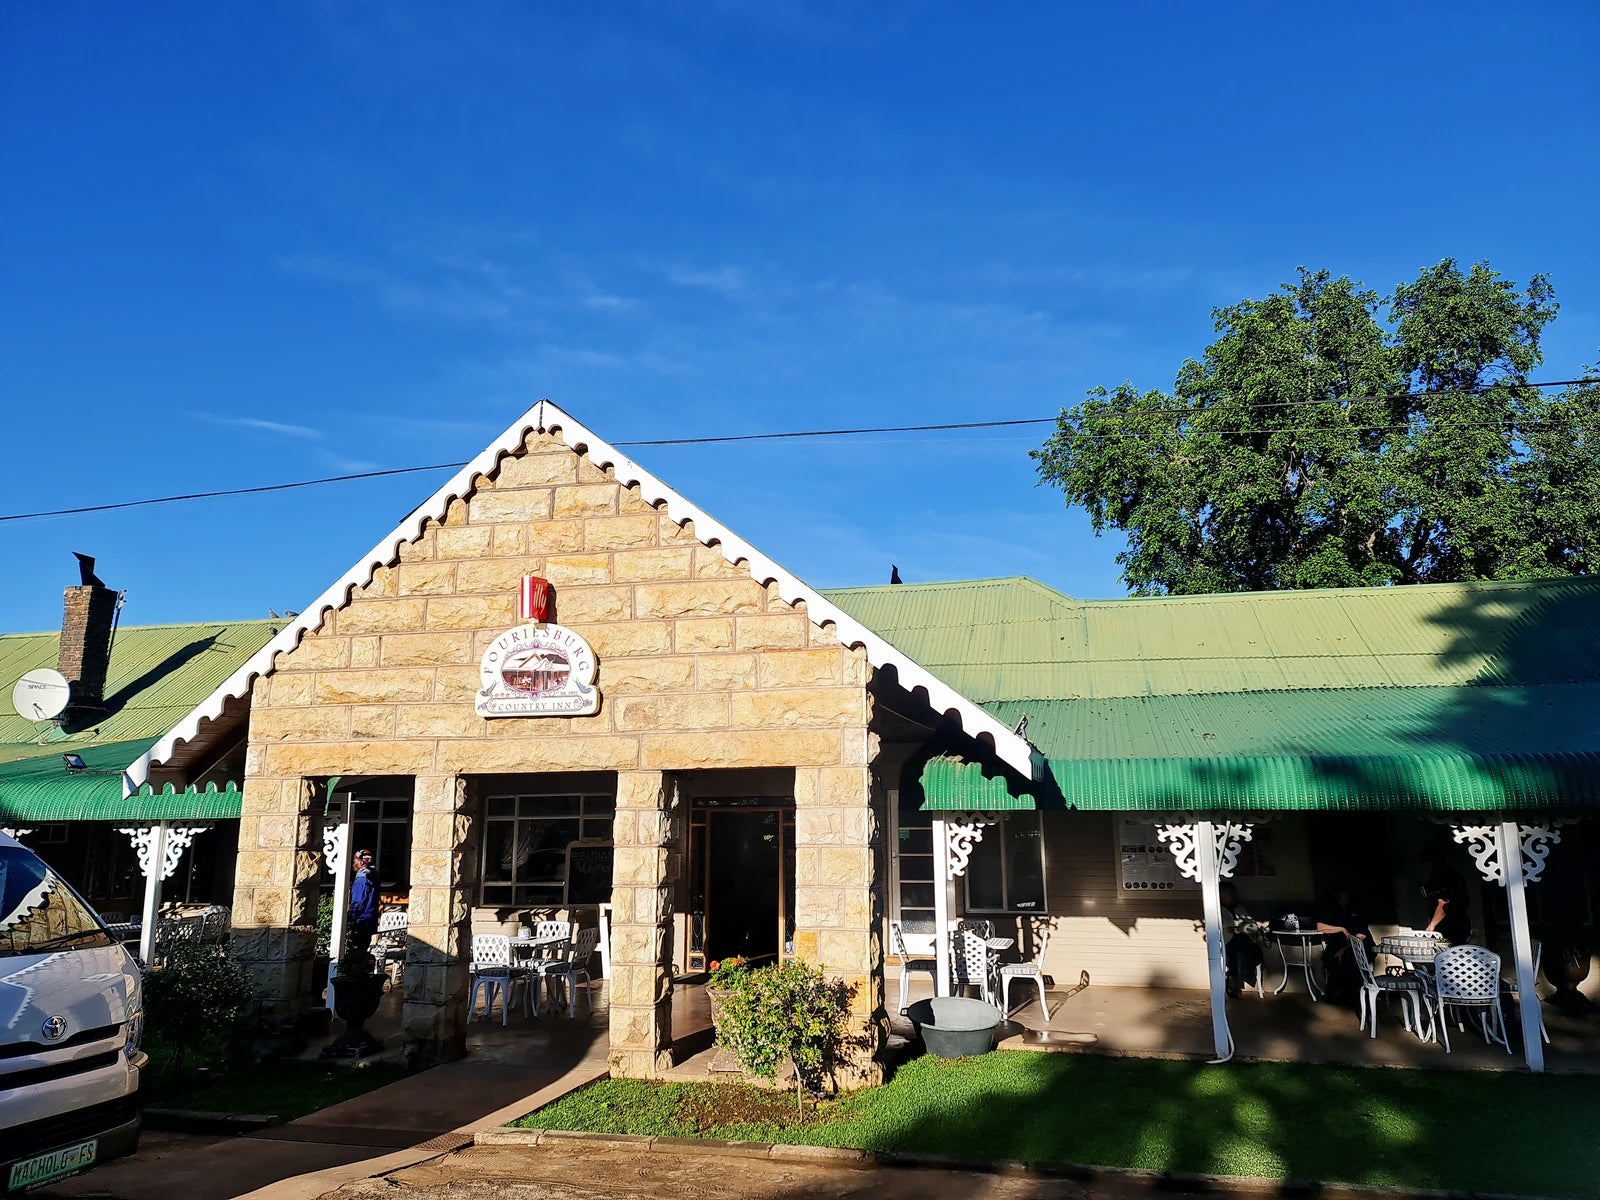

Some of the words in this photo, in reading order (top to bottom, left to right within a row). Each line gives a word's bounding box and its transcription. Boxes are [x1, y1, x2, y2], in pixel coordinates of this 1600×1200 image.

[533, 583, 547, 615] illy
[483, 627, 589, 674] FOURIESBURG
[498, 702, 547, 711] COUNTRY
[552, 701, 572, 710] INN
[79, 1143, 94, 1164] FS
